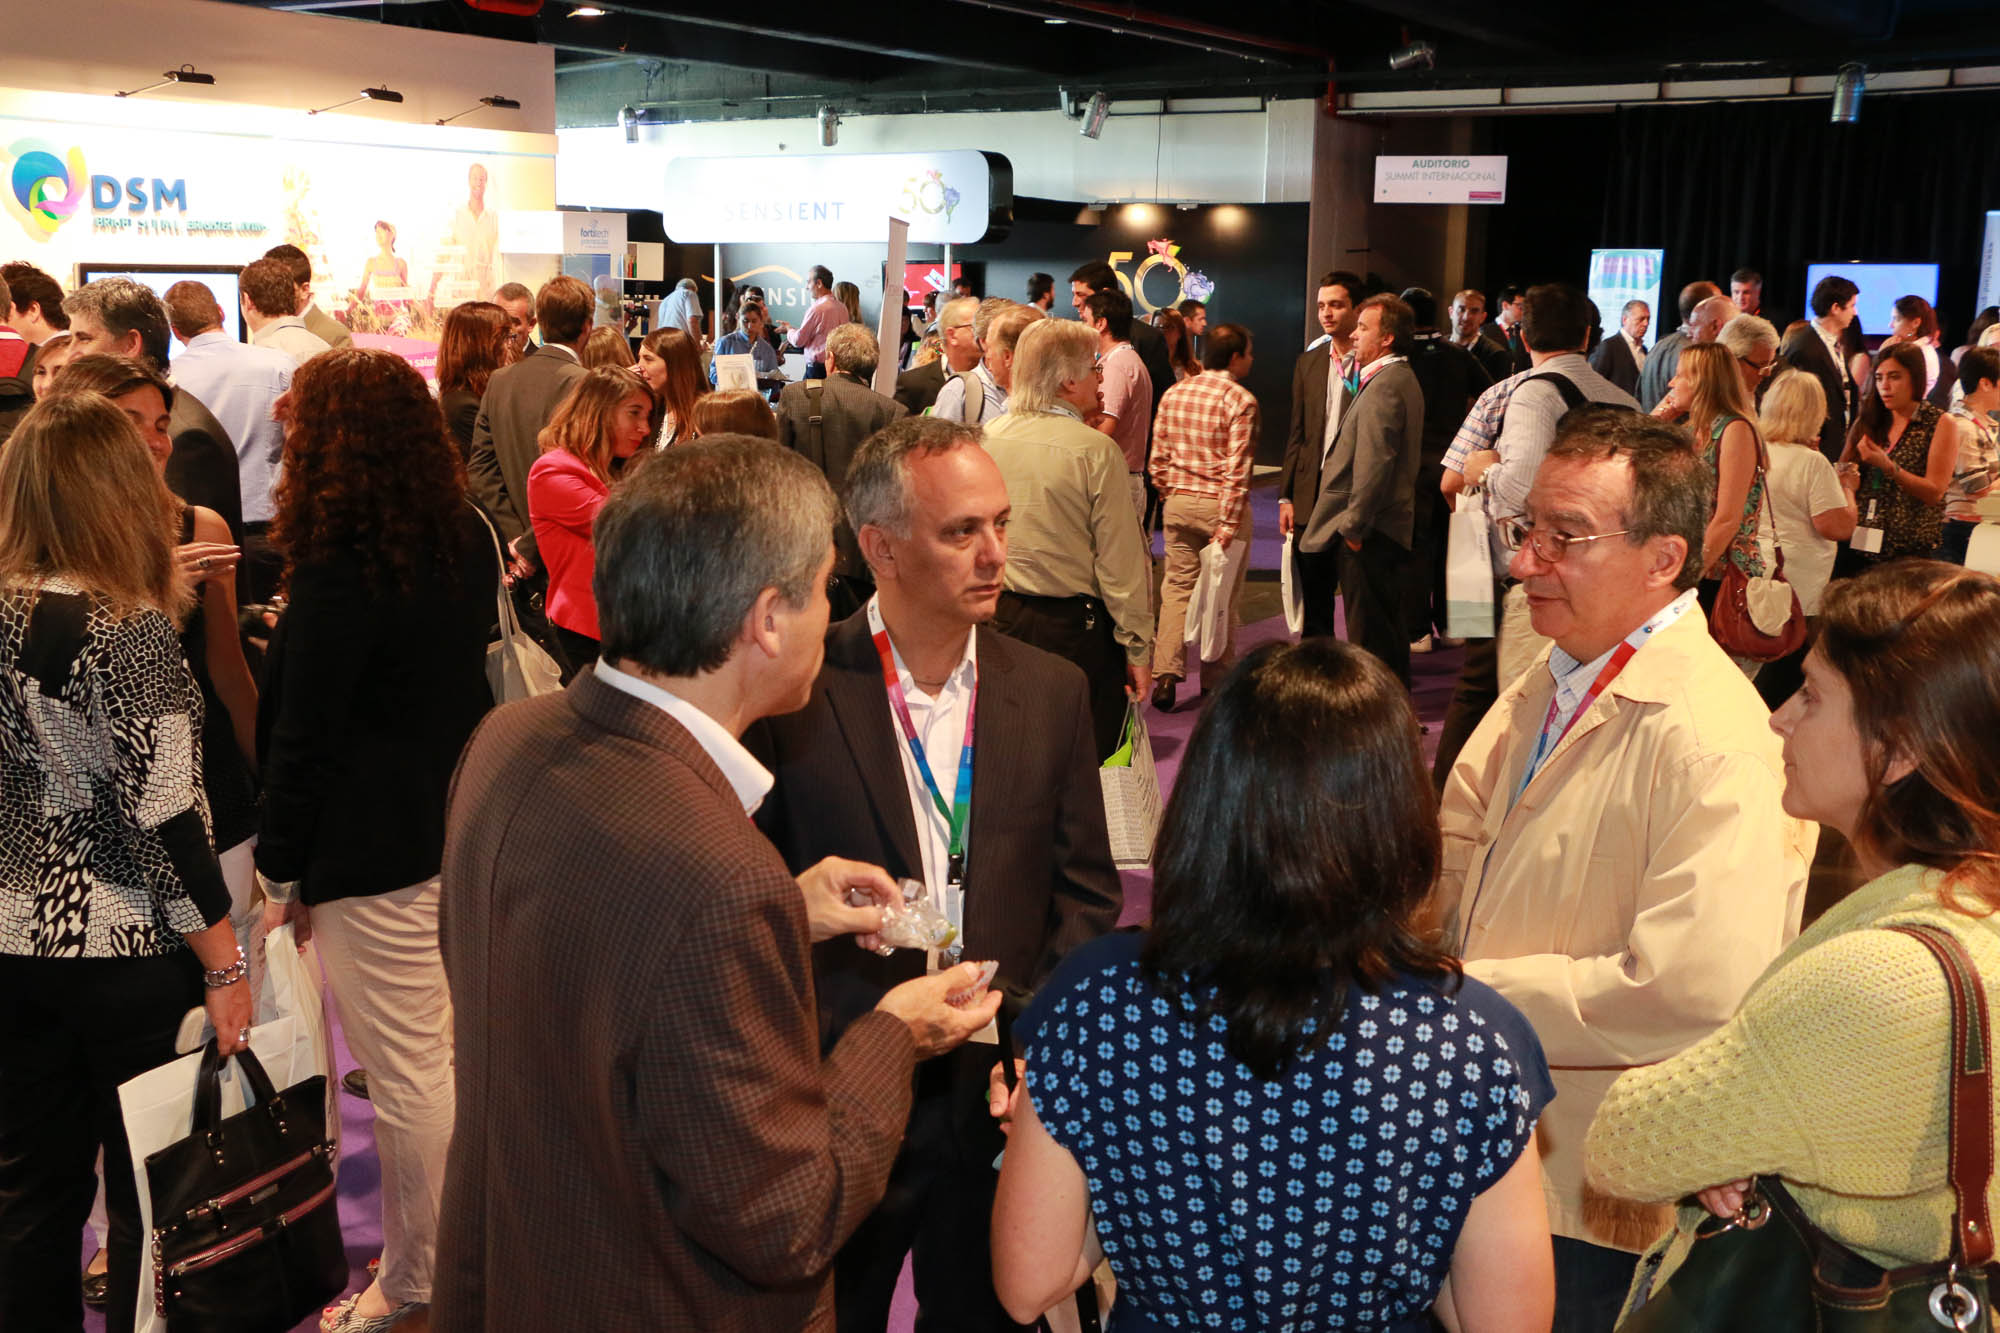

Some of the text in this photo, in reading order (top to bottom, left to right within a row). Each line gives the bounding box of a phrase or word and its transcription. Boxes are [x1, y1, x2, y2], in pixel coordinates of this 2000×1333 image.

[1412, 160, 1471, 169] AUDITORIO
[1385, 171, 1496, 181] SUMMIT INTERNACIONAL
[91, 174, 187, 212] DSM
[722, 201, 845, 222] SENSIENT
